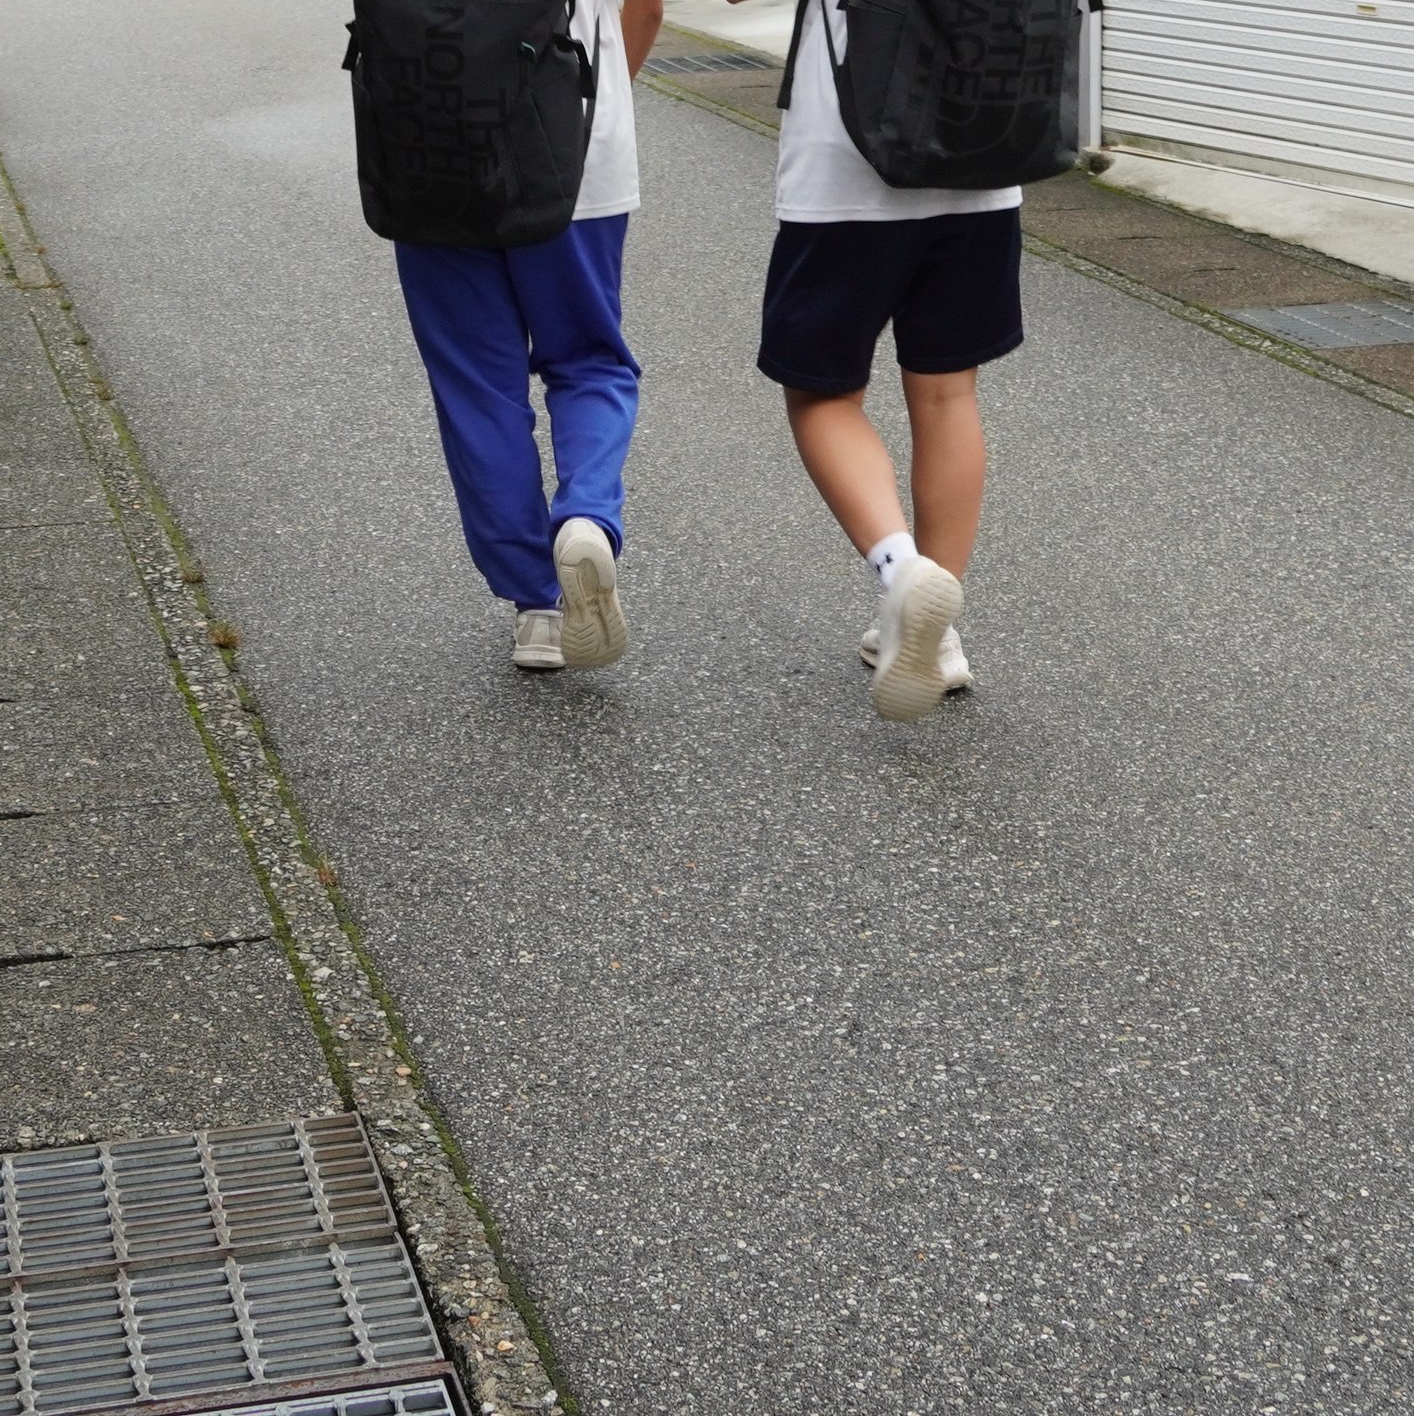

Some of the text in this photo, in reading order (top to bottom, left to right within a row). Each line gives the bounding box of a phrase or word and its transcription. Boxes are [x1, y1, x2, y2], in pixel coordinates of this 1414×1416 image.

[425, 7, 467, 177] NORTH
[1025, 0, 1066, 95] THE
[391, 56, 426, 172] FACE
[465, 88, 508, 178] THE
